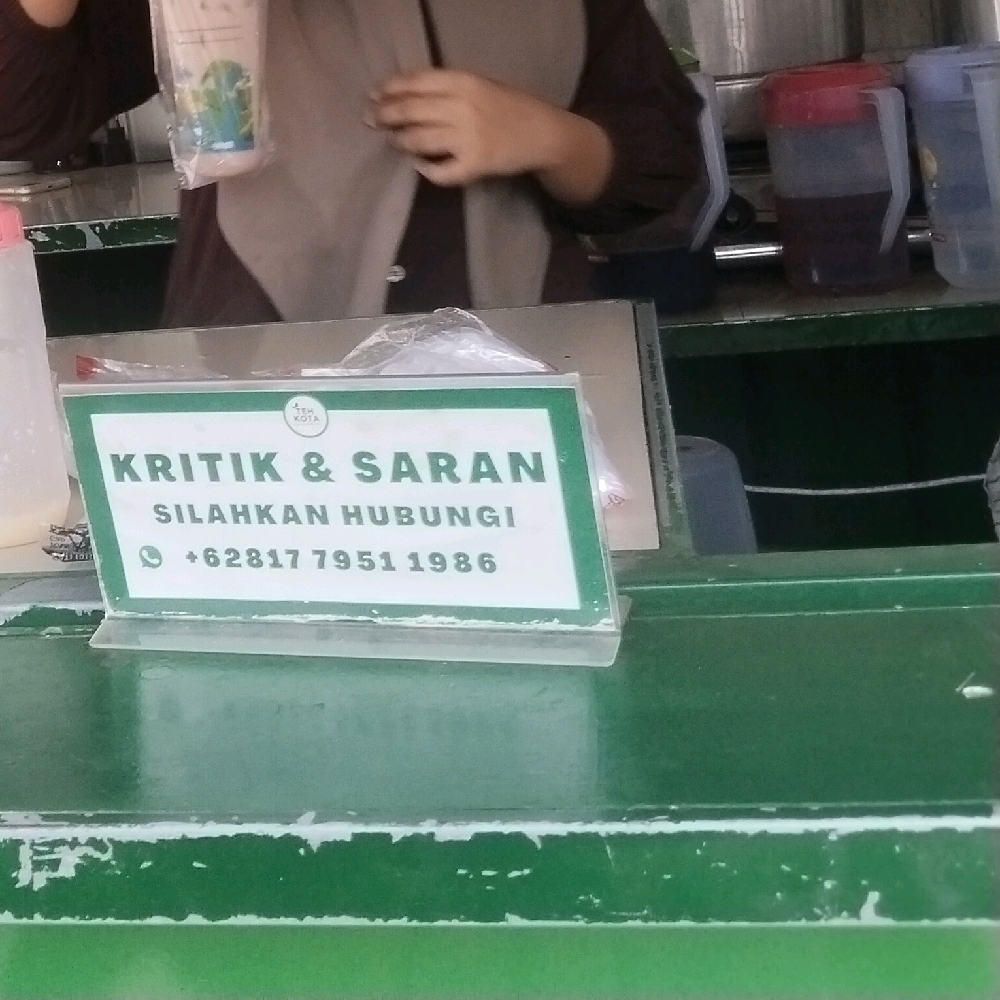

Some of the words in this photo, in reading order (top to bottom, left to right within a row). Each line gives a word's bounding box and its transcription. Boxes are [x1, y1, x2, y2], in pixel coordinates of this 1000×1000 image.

[295, 407, 314, 415] TEH
[109, 451, 285, 484] KRITIK
[301, 452, 335, 483] &
[353, 450, 547, 484] SARAN
[154, 503, 329, 526] SILAHKAN
[342, 504, 516, 528] HUBUNGI
[185, 547, 300, 570] +62817
[311, 549, 397, 572] 7951
[407, 551, 498, 575] 1986
